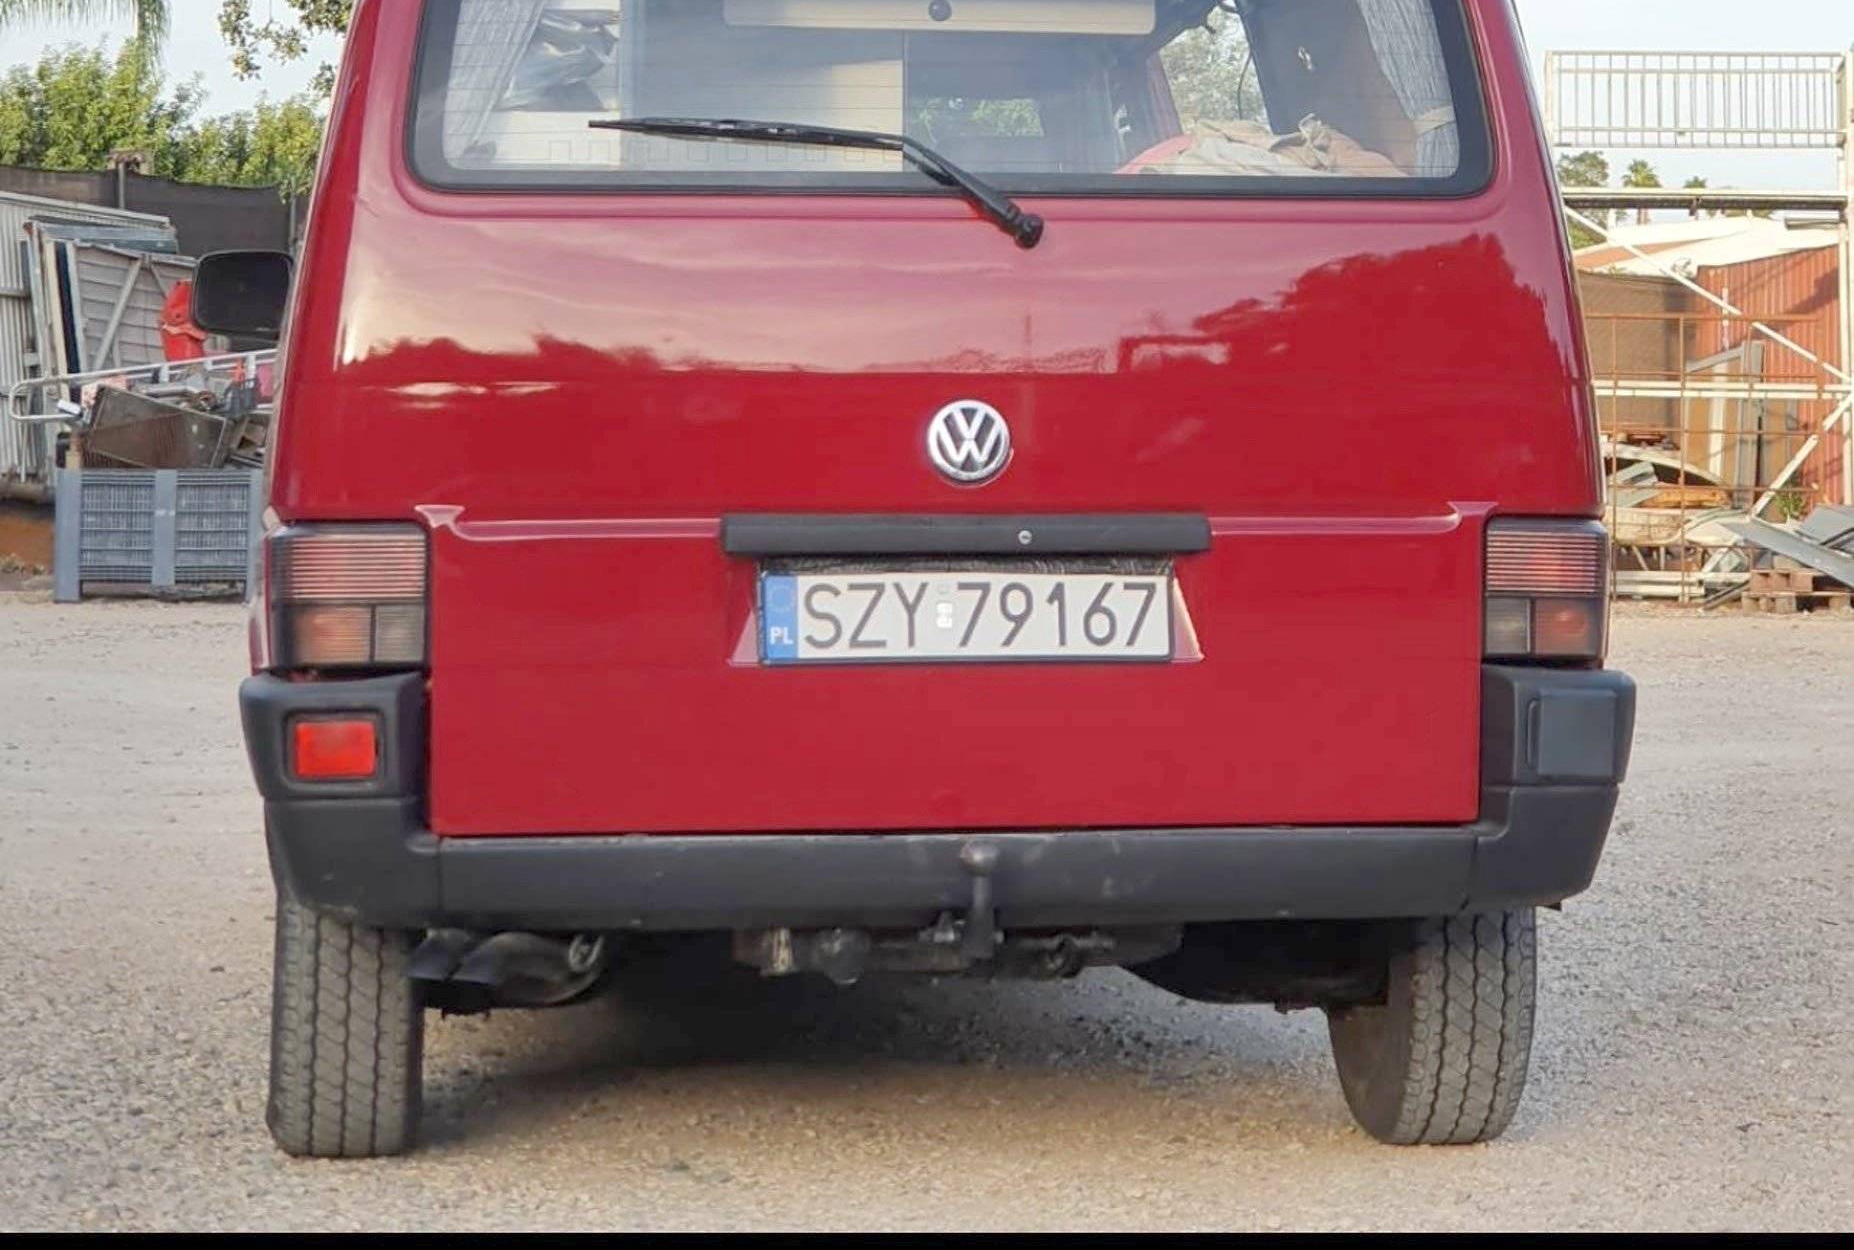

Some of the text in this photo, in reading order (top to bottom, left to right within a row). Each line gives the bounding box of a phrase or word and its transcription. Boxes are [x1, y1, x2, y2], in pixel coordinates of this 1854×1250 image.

[769, 627, 793, 645] PL
[803, 581, 1157, 649] SZY 79167
